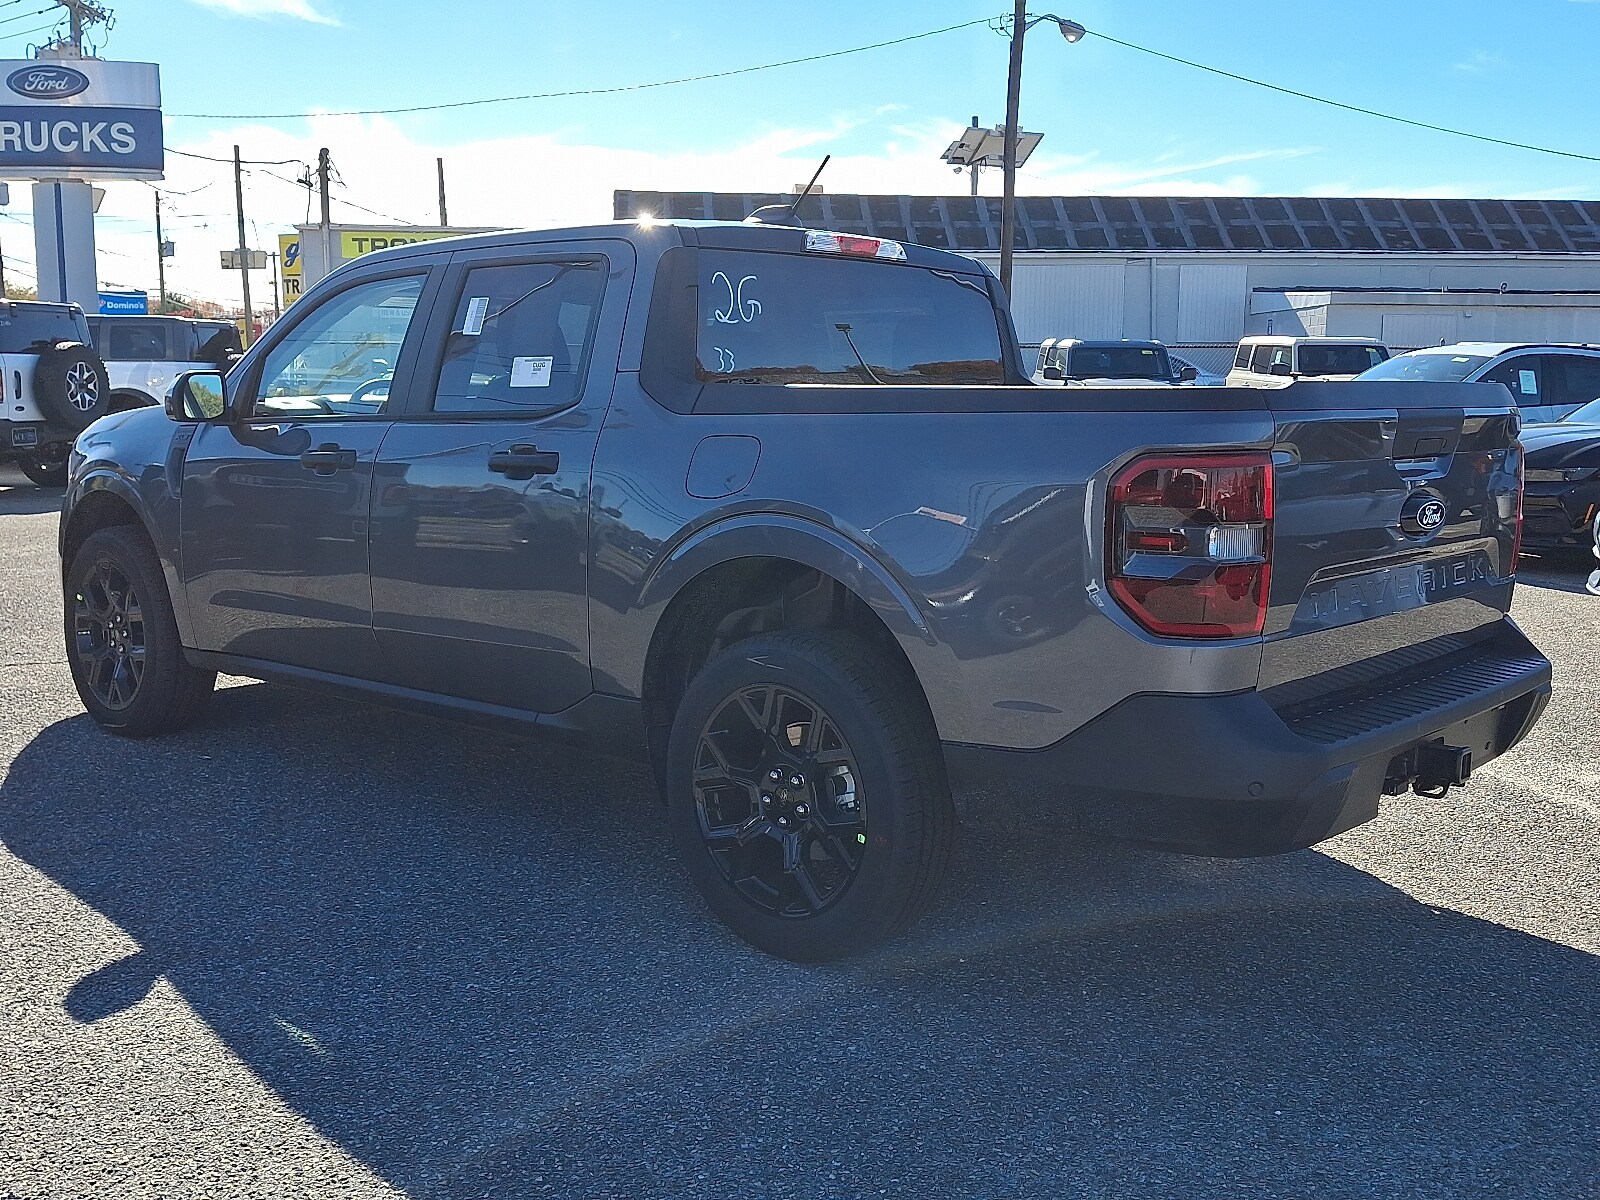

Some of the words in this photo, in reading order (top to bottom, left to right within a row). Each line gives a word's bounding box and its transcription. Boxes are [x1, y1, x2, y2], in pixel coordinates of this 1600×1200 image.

[24, 71, 69, 91] Ford
[0, 120, 137, 154] RUCKS
[283, 279, 302, 294] TR
[106, 301, 145, 310] Domino's
[1422, 505, 1442, 524] Ford
[1310, 554, 1486, 618] MAVERICK
